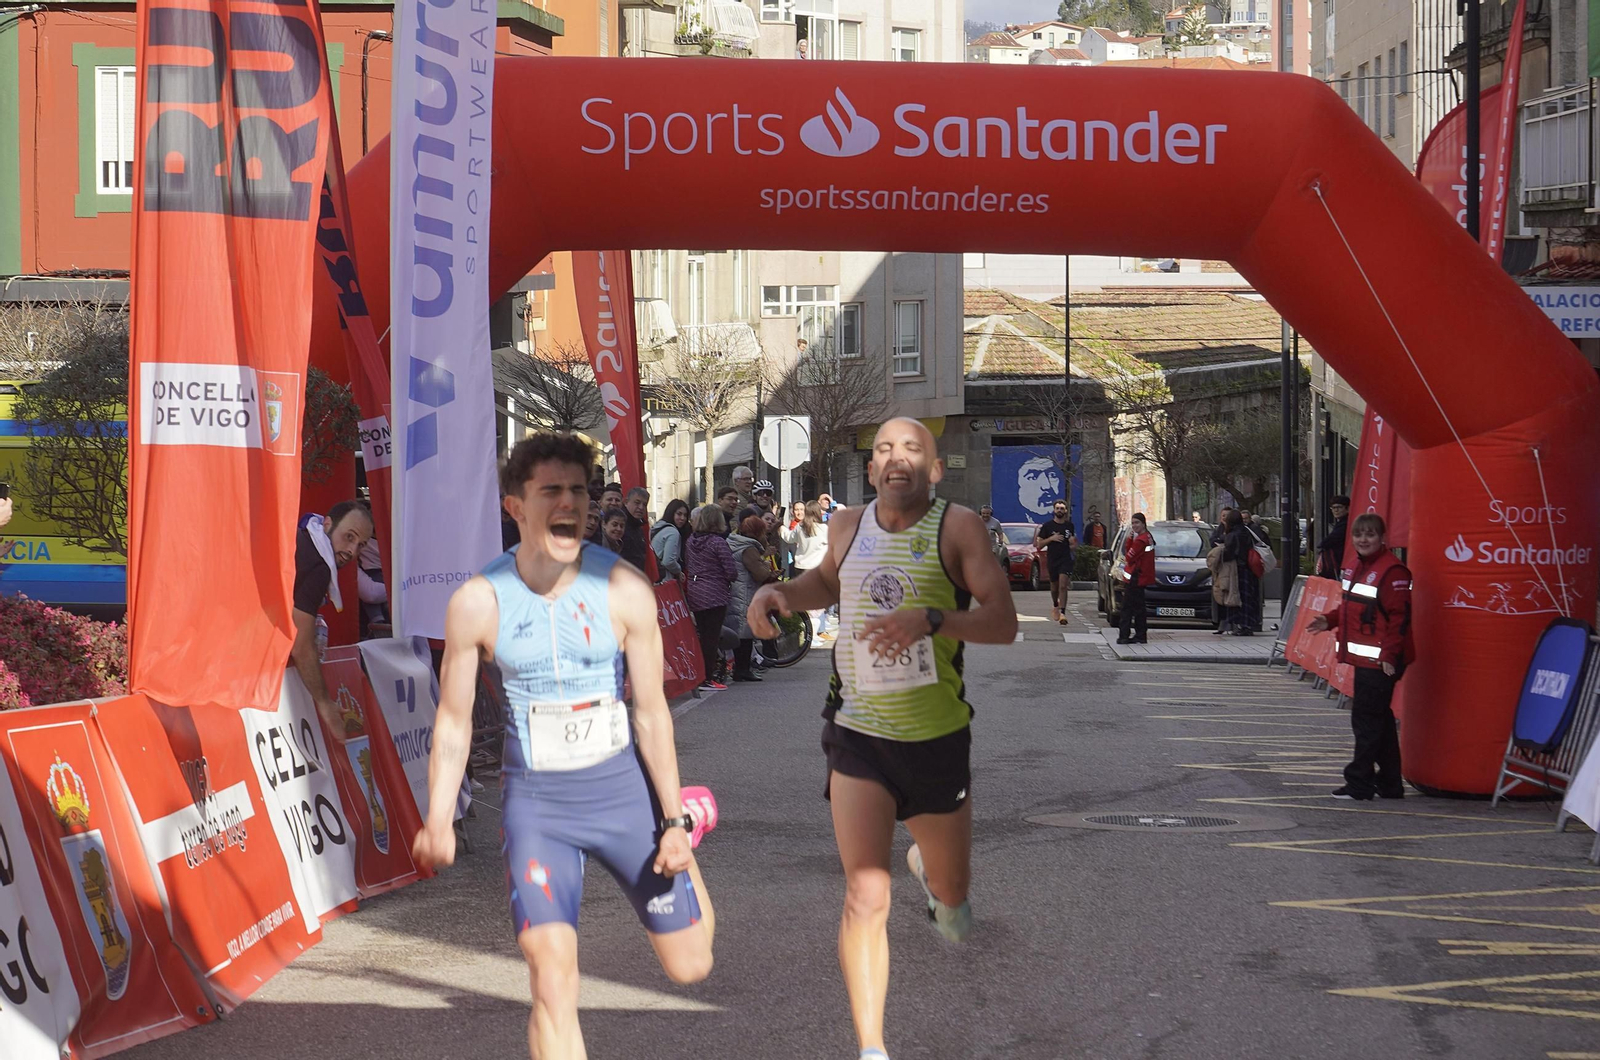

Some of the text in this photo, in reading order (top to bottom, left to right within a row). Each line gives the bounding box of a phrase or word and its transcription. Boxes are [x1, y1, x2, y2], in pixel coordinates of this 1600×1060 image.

[229, 0, 321, 221] RU
[580, 97, 1228, 170] Sports Santander
[412, 0, 459, 318] amur
[760, 185, 1049, 215] sportssantander.es
[156, 406, 250, 428] DE VIGO
[1488, 500, 1567, 528] Sports
[1477, 541, 1592, 565] Santander
[565, 719, 593, 744] 87
[284, 793, 346, 863] VIGO
